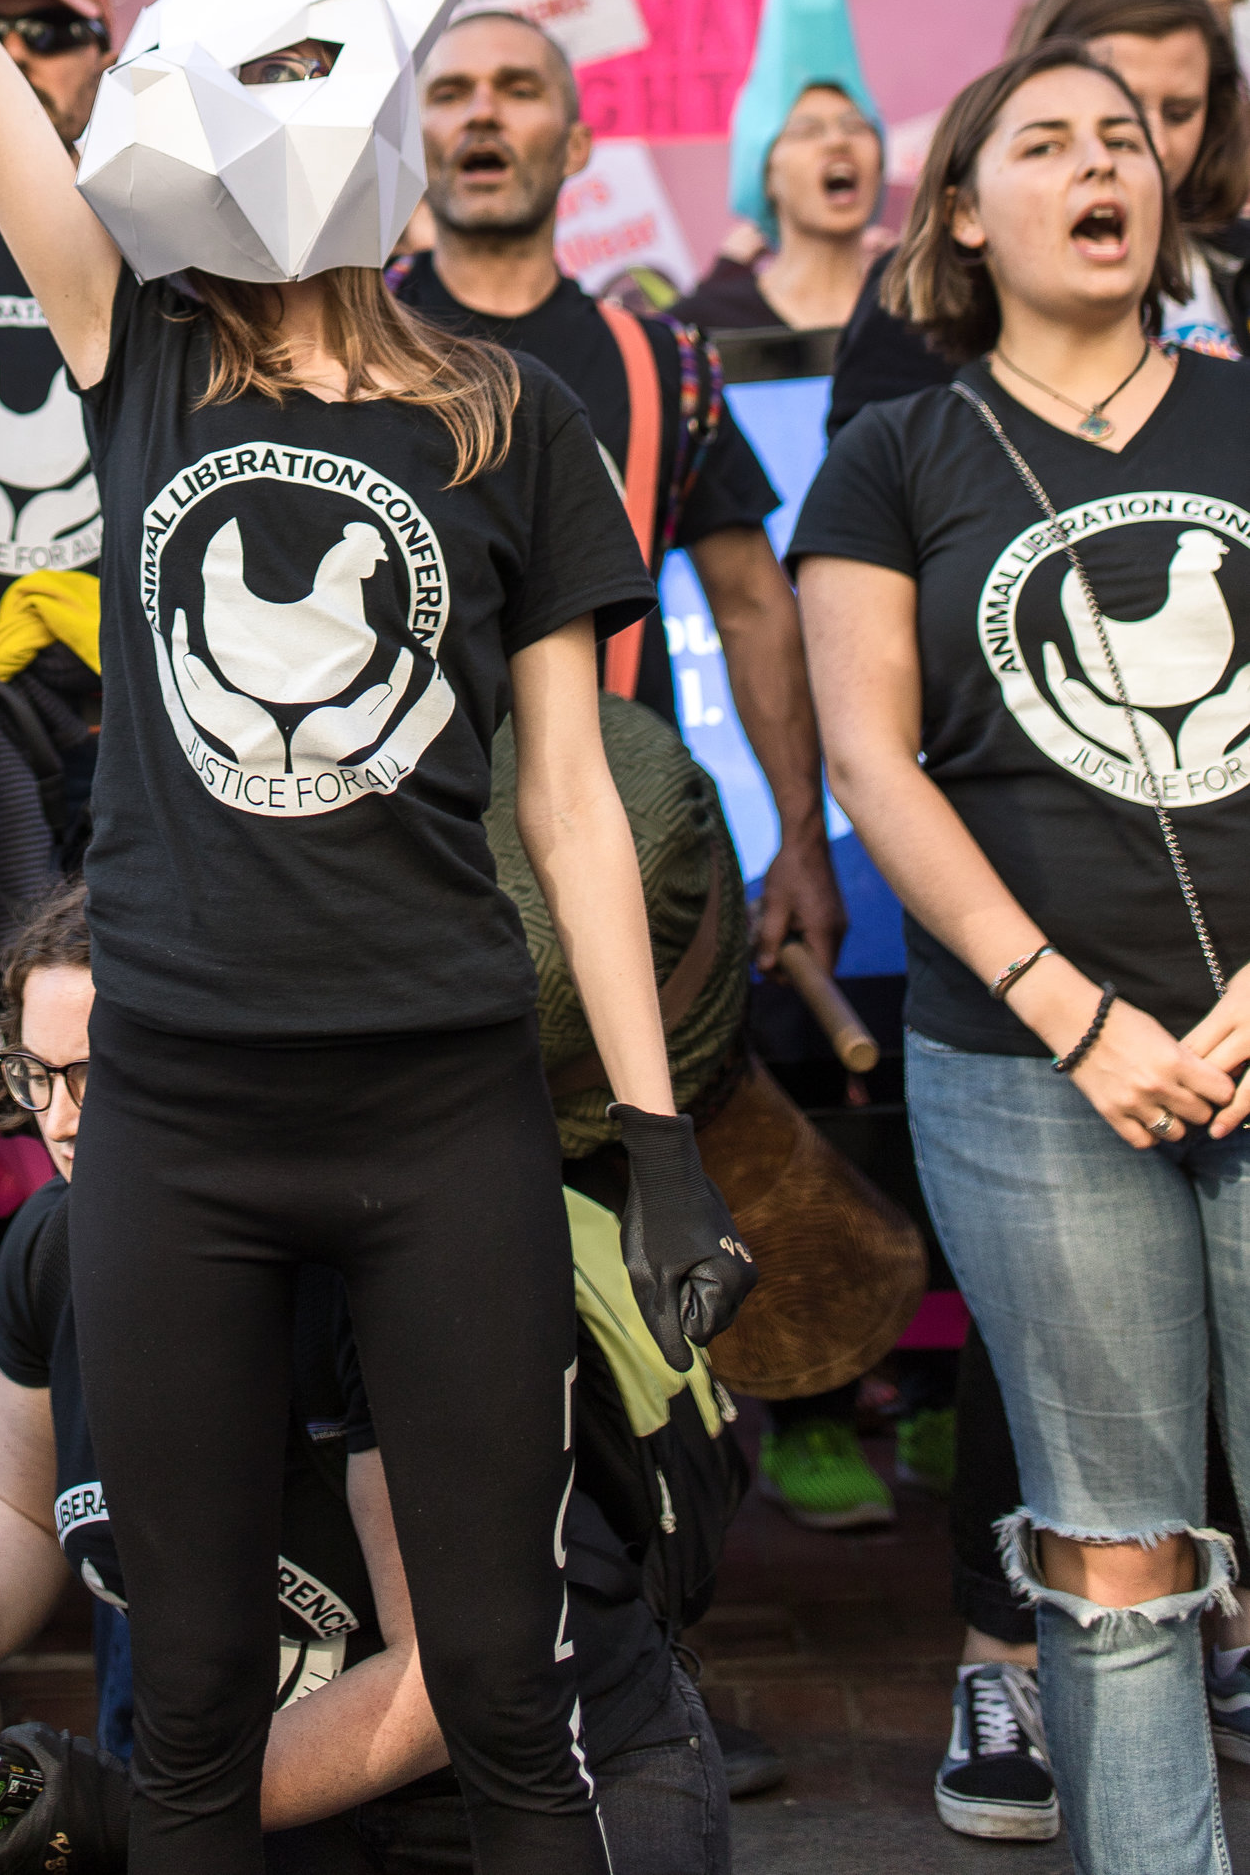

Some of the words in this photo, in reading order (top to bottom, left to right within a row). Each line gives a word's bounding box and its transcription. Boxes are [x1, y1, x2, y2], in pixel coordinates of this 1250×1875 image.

[169, 449, 366, 510] LIBERATION
[15, 543, 69, 570] FOR
[986, 568, 1024, 673] ANIMAL
[1183, 500, 1250, 537] CON
[186, 737, 286, 808] JUSTICE
[296, 769, 363, 808] FOR
[365, 754, 409, 789] ALL
[1064, 747, 1180, 800] JUSTICE
[1187, 757, 1247, 798] FOR
